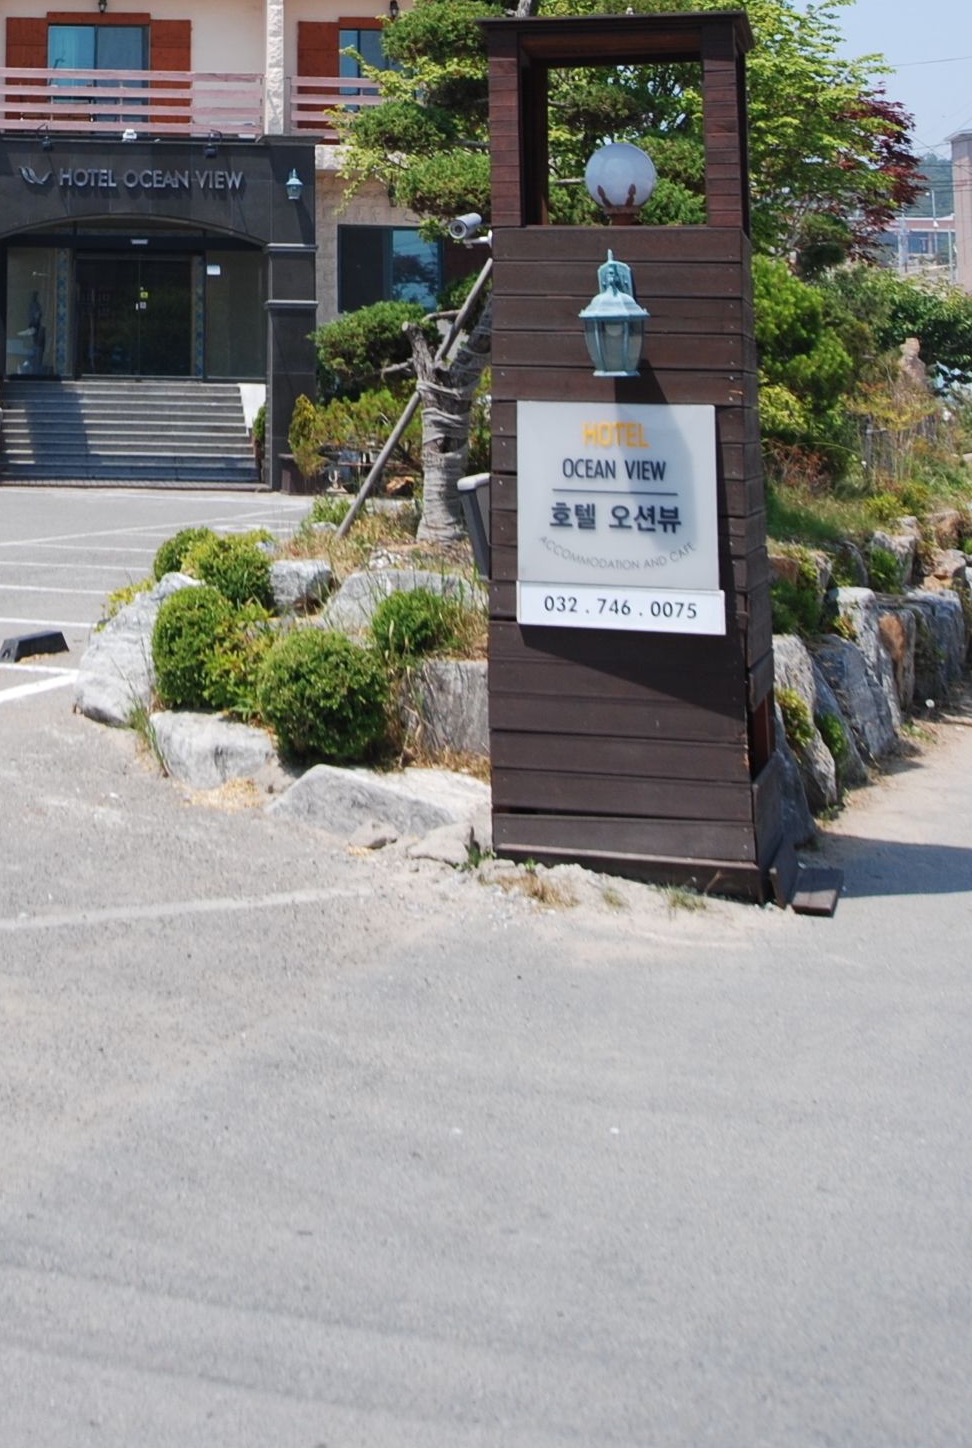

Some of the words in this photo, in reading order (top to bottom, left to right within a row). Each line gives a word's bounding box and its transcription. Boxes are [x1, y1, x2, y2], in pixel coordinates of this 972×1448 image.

[58, 168, 117, 188] HOTEL
[123, 169, 190, 189] OCEAN
[194, 170, 244, 190] VIEW
[580, 420, 651, 449] HOTEL
[562, 457, 616, 480] OCEAN
[624, 459, 667, 482] VIEW
[549, 501, 597, 530] 호텔
[608, 504, 682, 534] 오션뷰
[538, 535, 641, 571] ACCOMMODATION
[643, 555, 668, 570] AND
